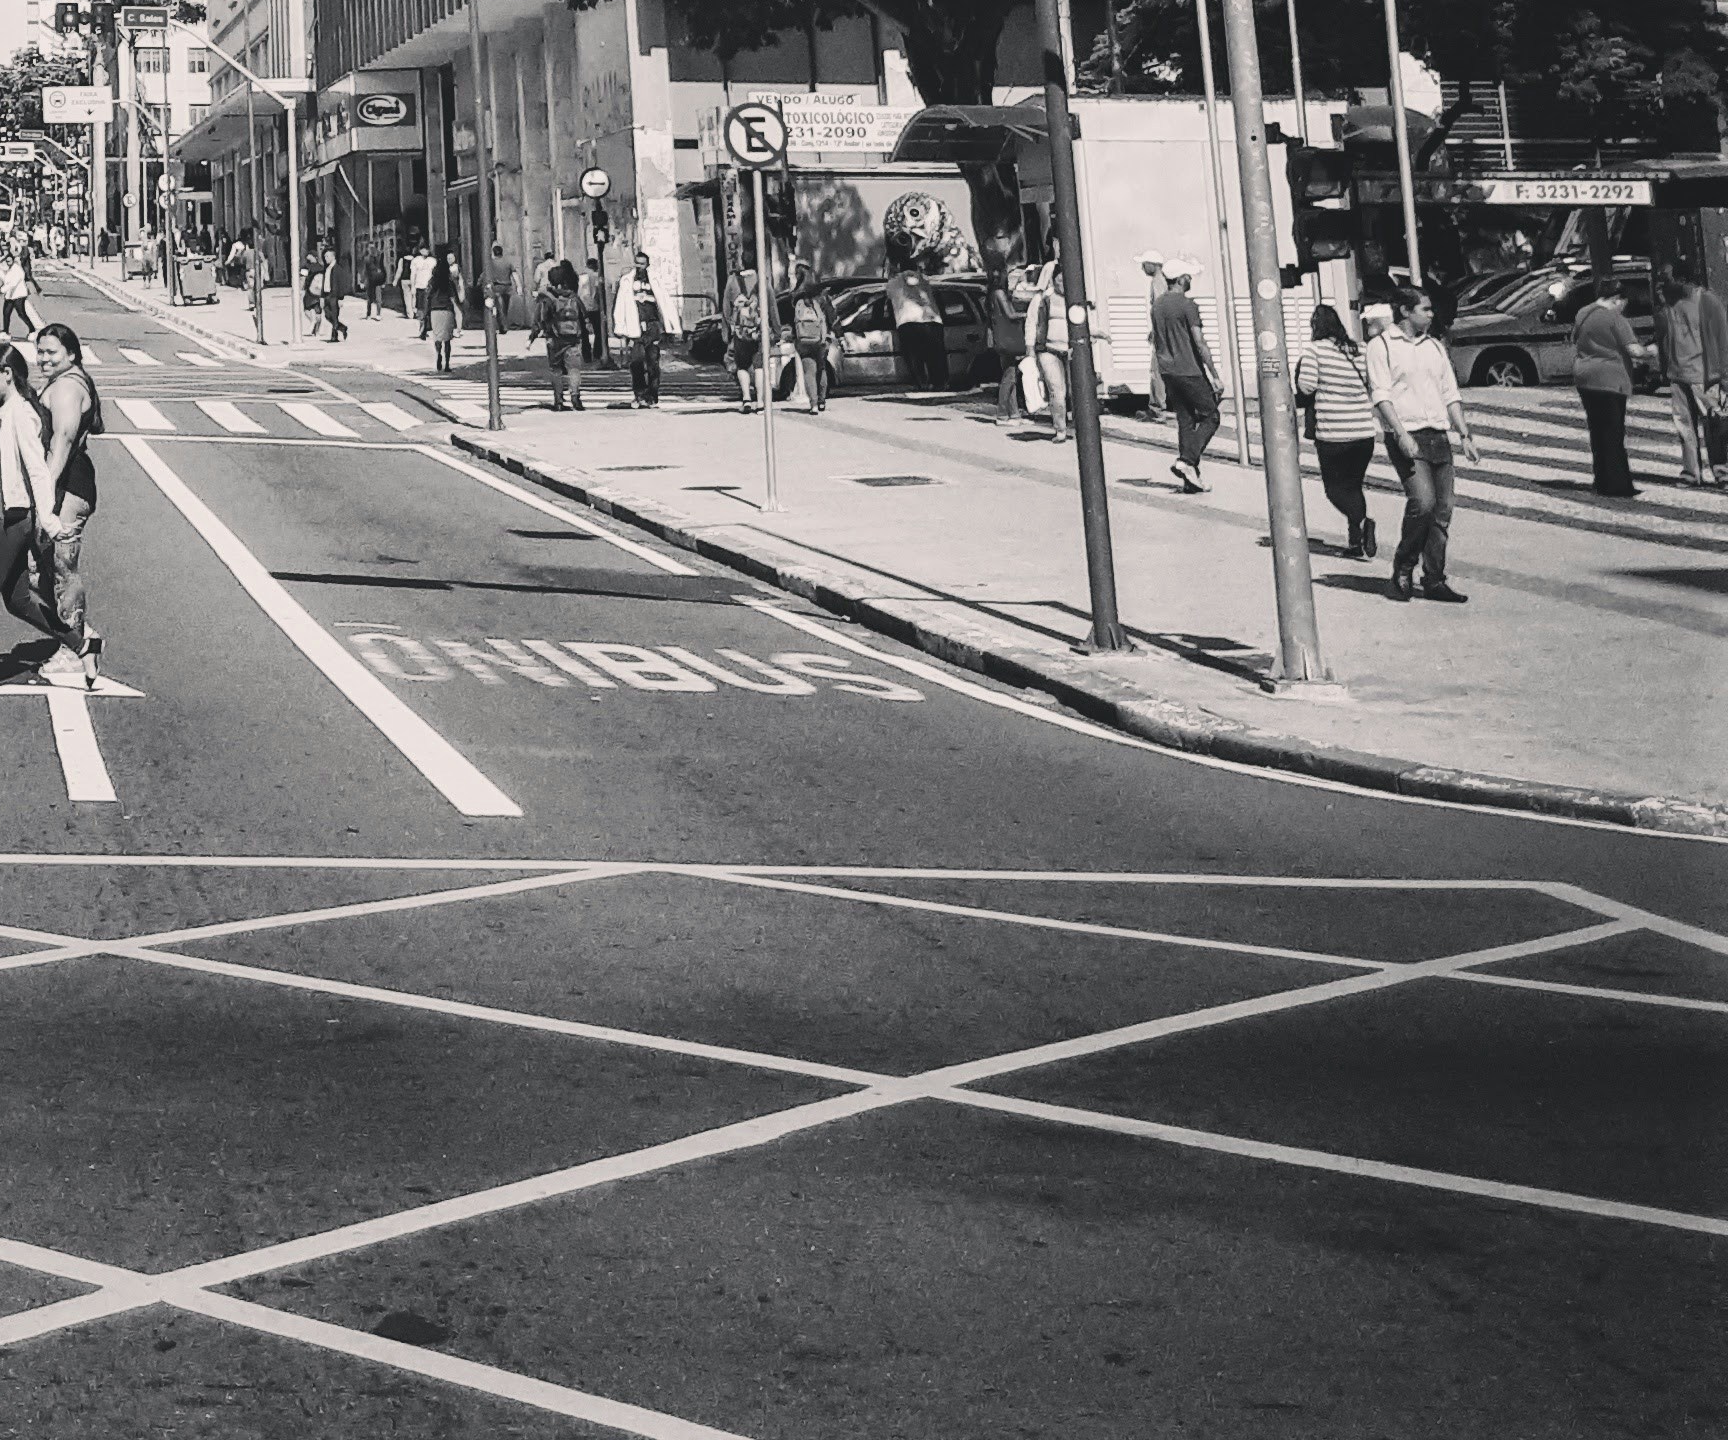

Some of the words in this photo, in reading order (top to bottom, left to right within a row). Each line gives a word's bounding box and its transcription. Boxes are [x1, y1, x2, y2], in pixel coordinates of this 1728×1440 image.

[785, 109, 875, 124] TOXICOLÓGICO
[1515, 185, 1529, 199] F:
[1536, 184, 1635, 199] 3231-2292
